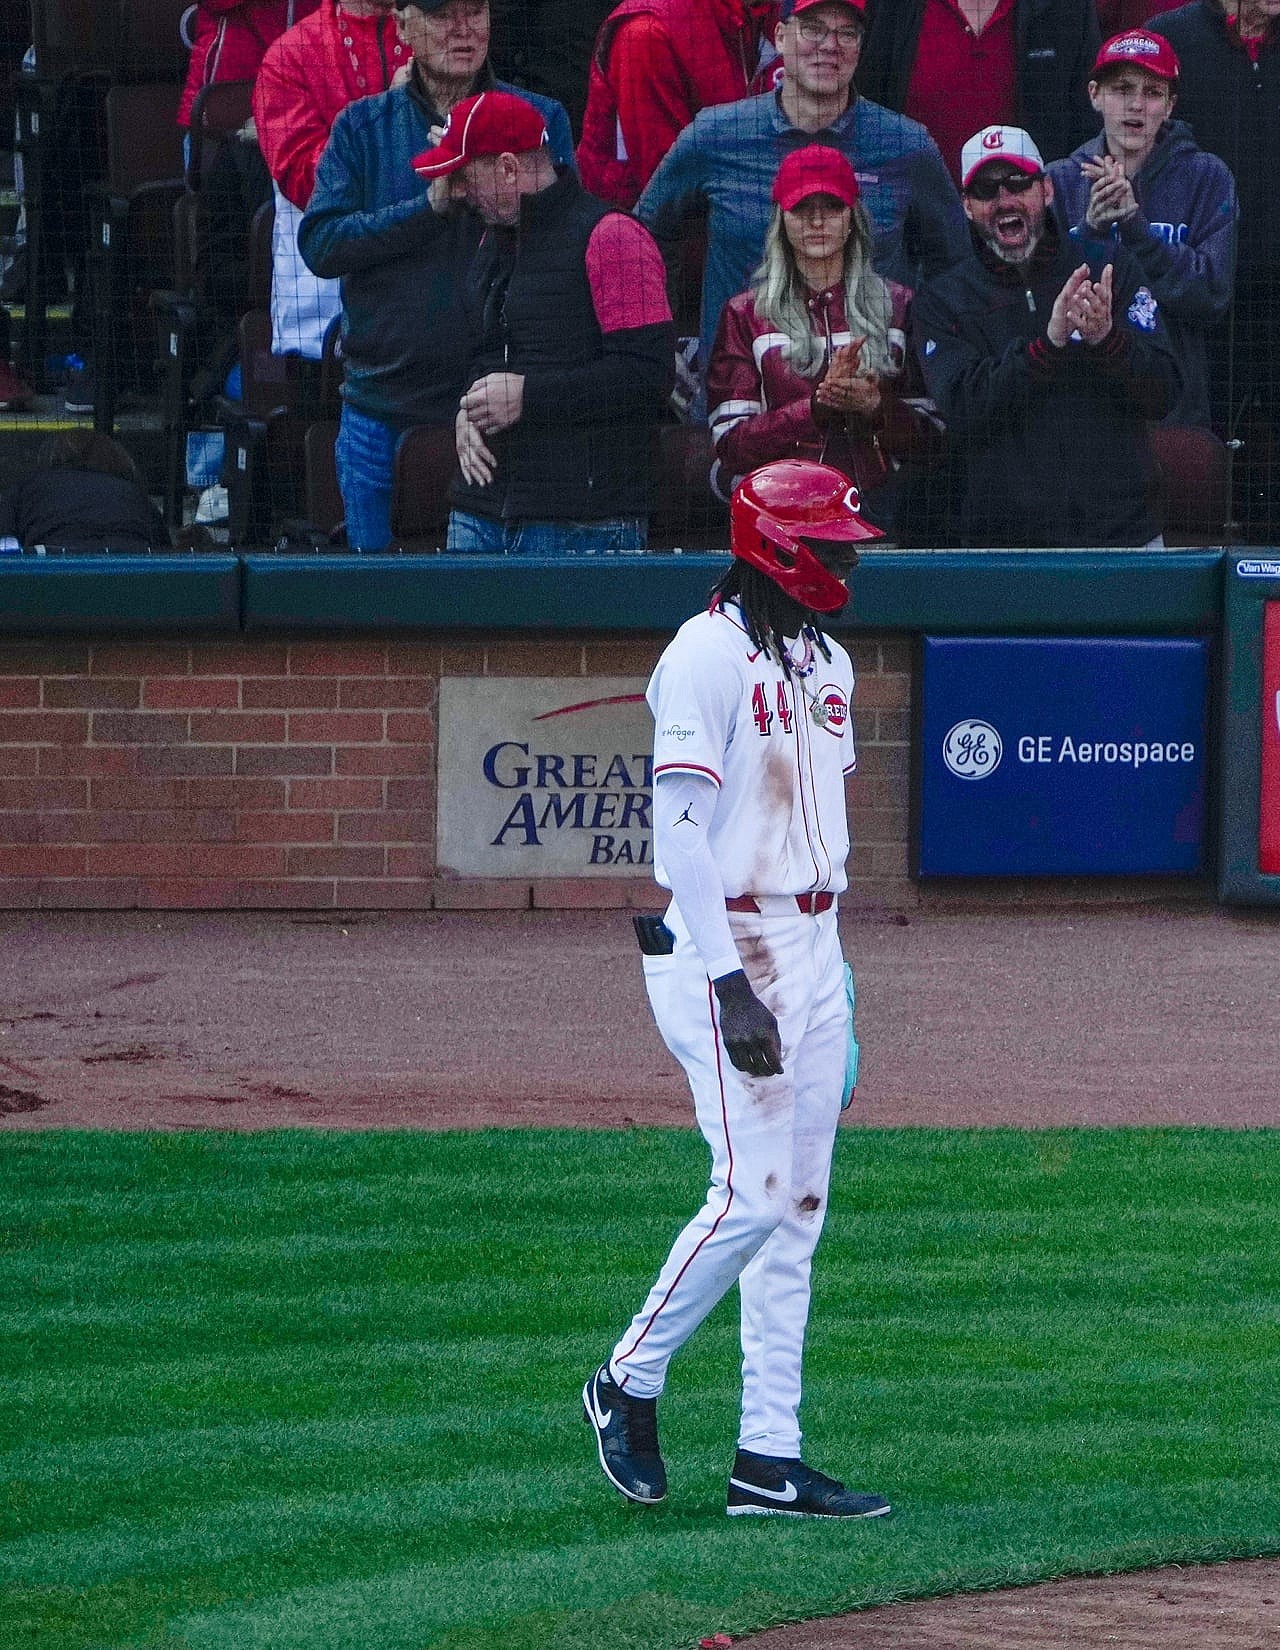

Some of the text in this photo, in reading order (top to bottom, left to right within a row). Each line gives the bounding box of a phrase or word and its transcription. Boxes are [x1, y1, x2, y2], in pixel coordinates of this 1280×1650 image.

[843, 486, 861, 512] C
[1242, 562, 1260, 573] Van
[752, 680, 792, 736] 44
[667, 724, 696, 741] Kroger
[1018, 735, 1195, 768] GE Aerospace
